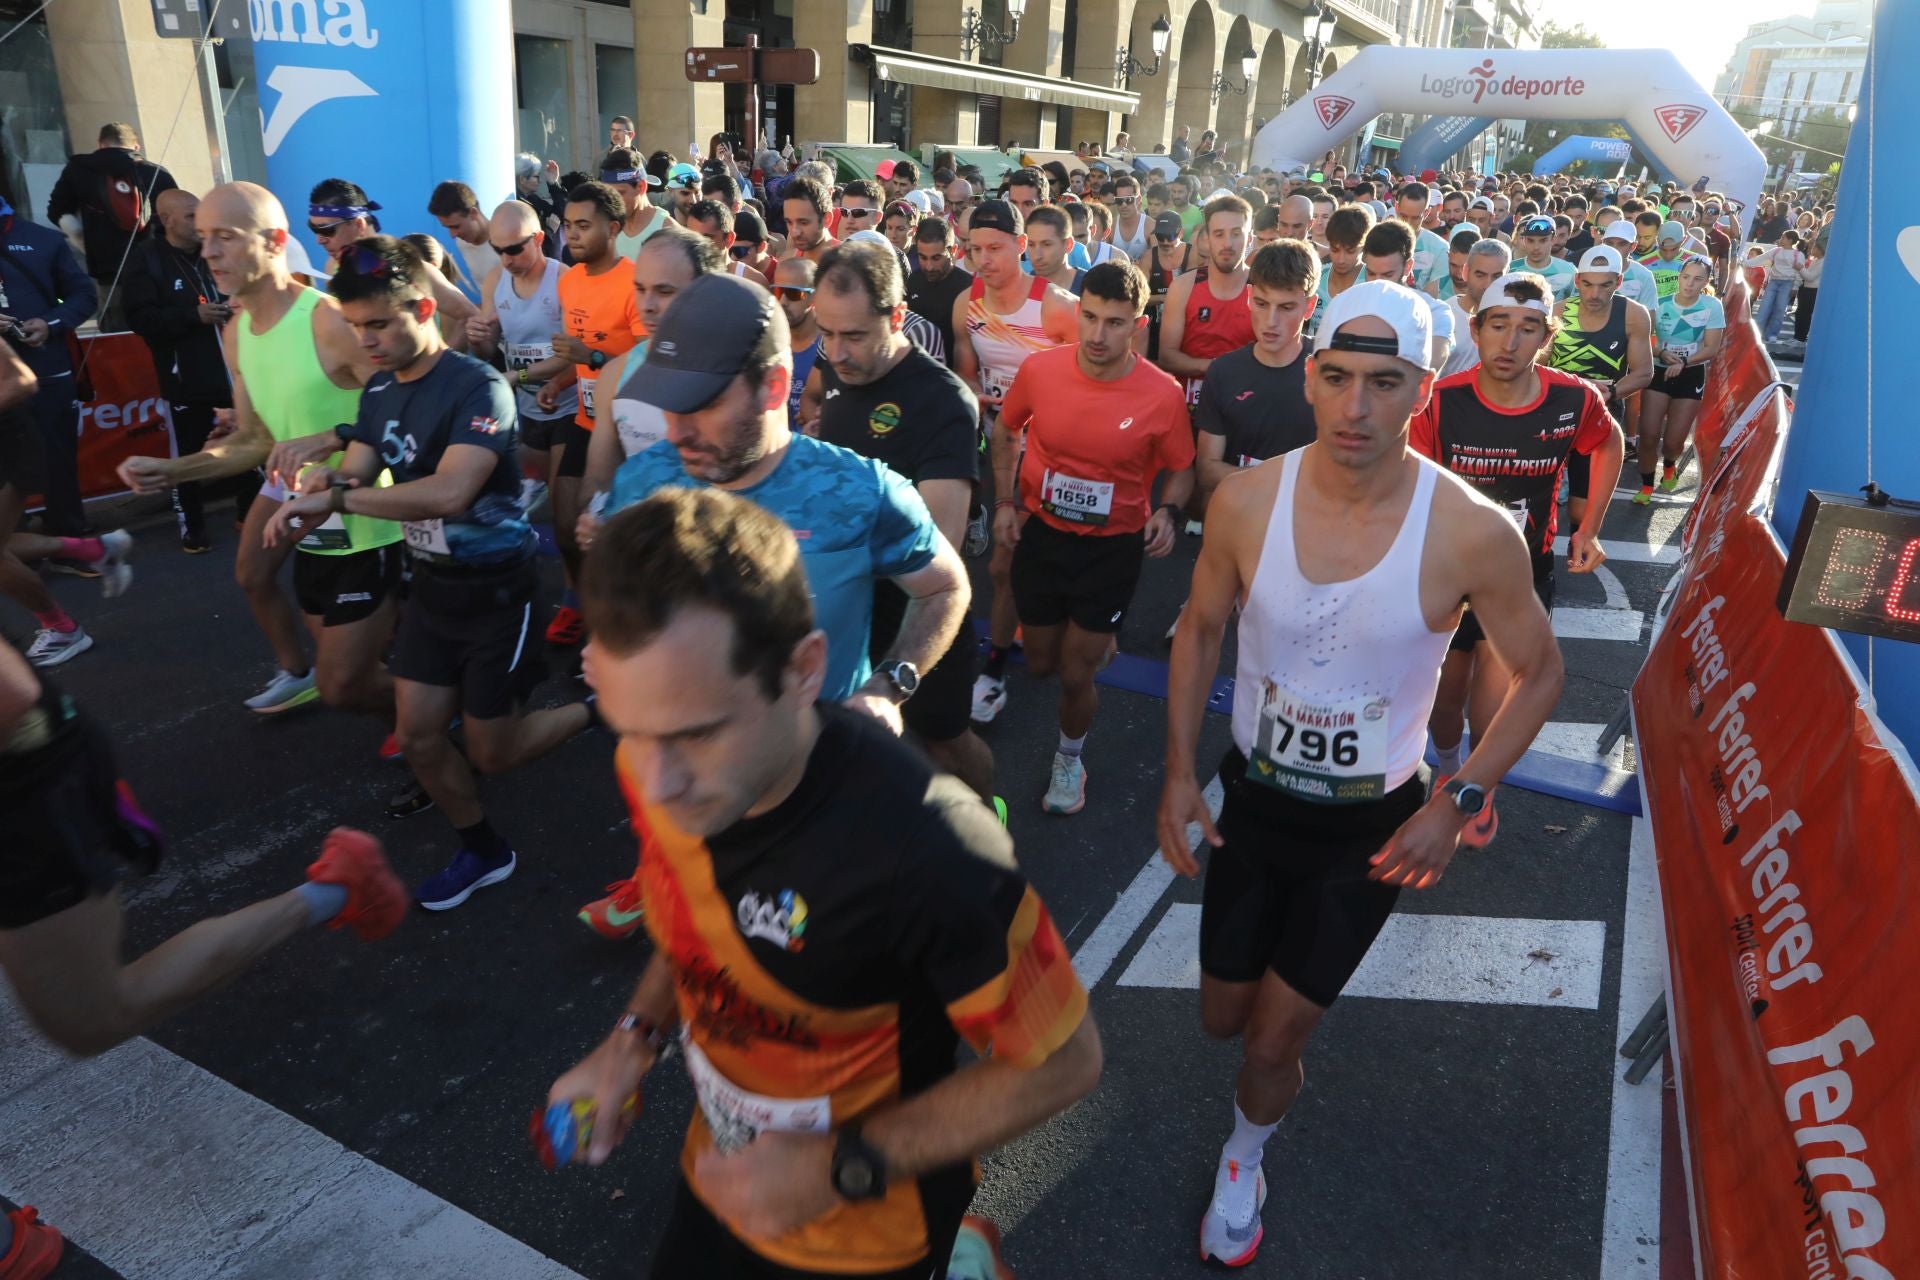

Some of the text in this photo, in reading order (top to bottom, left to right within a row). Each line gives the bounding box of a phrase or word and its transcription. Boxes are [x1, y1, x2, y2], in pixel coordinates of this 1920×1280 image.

[247, 0, 379, 49] oma
[1501, 75, 1585, 100] deporte
[1590, 141, 1631, 151] POWER
[1450, 454, 1558, 477] AZKOITIAZPEITIA
[1463, 445, 1483, 456] MEDIA
[1485, 446, 1518, 458] MARATÓN
[1055, 488, 1098, 507] 1658
[1681, 595, 1730, 694] ferrer
[1283, 701, 1355, 728] LA MARATÓN
[1276, 715, 1360, 767] 796
[1708, 682, 1771, 814] ferrer
[1716, 793, 1735, 833] center
[1740, 809, 1824, 991] ferrer
[1731, 913, 1760, 1001] sport center
[1804, 1228, 1836, 1280] cent
